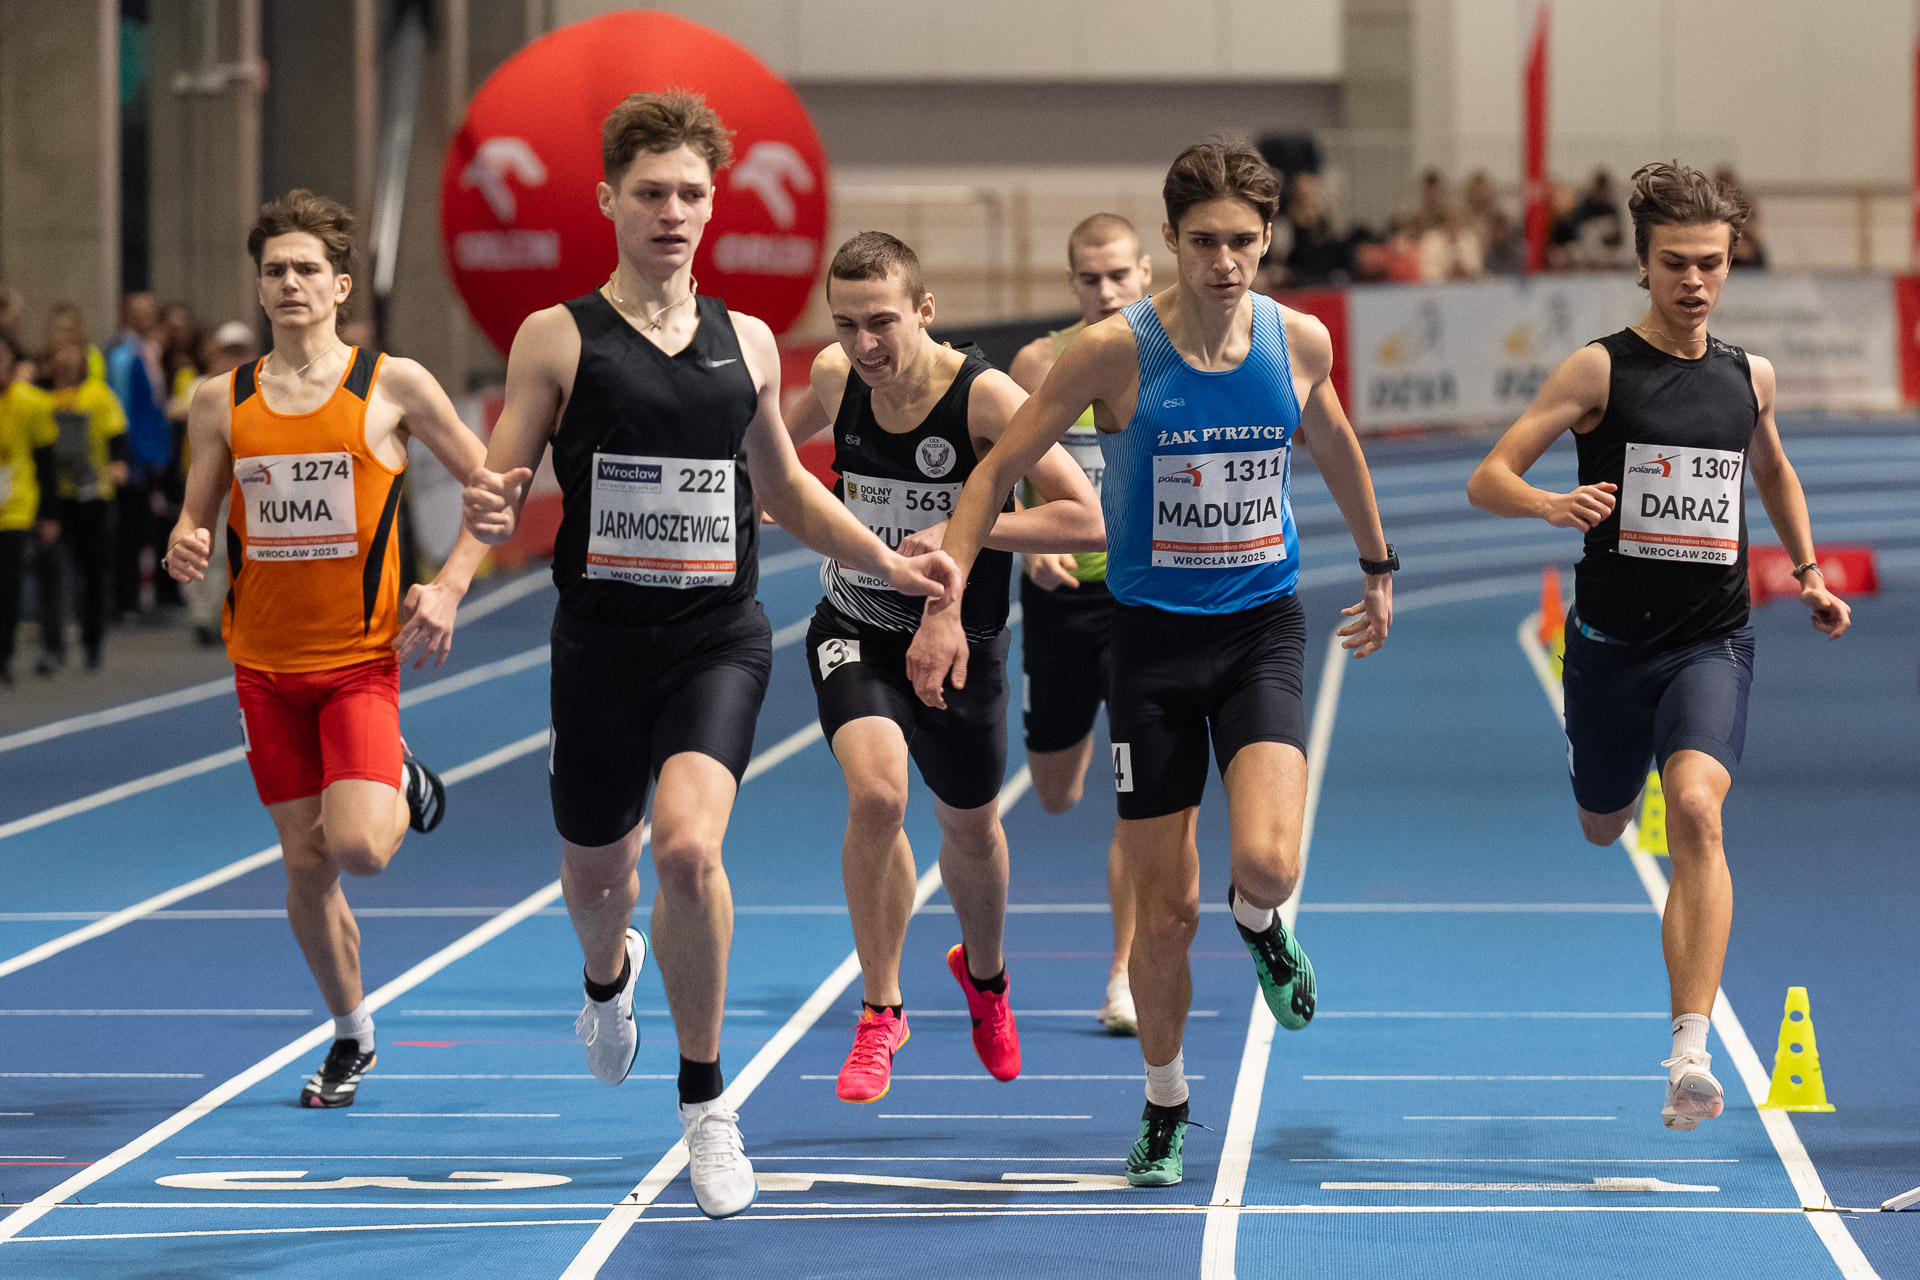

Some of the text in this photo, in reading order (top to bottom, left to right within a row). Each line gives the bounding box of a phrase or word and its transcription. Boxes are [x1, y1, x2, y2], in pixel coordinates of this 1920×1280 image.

[1157, 426, 1285, 447] ŻAK PYRZYCE
[292, 460, 349, 481] 1274
[602, 464, 659, 479] Wrocław
[1157, 475, 1193, 484] polanik
[1224, 456, 1280, 483] 1311
[1628, 466, 1662, 475] polanik
[1692, 457, 1740, 481] 1307
[678, 468, 726, 493] 222
[861, 485, 892, 496] DOLNY
[260, 499, 333, 523] KUMA
[905, 490, 952, 511] 563
[1641, 493, 1730, 523] DARAŻ
[1158, 496, 1278, 528] MADUZIA
[597, 510, 730, 543] JARMOSZEWICZ
[257, 547, 338, 559] WROCŁAW 2025
[1173, 544, 1198, 552] Halowe
[1199, 544, 1238, 552] Mistrzostwa
[1239, 541, 1256, 550] Polski
[1638, 546, 1727, 561] WROCŁAW 2025
[1173, 551, 1266, 566] WROCŁAW 2025
[610, 571, 714, 586] WROCŁAW 2025
[857, 575, 889, 587] WROC
[826, 640, 849, 668] 3
[1114, 746, 1124, 788] 4
